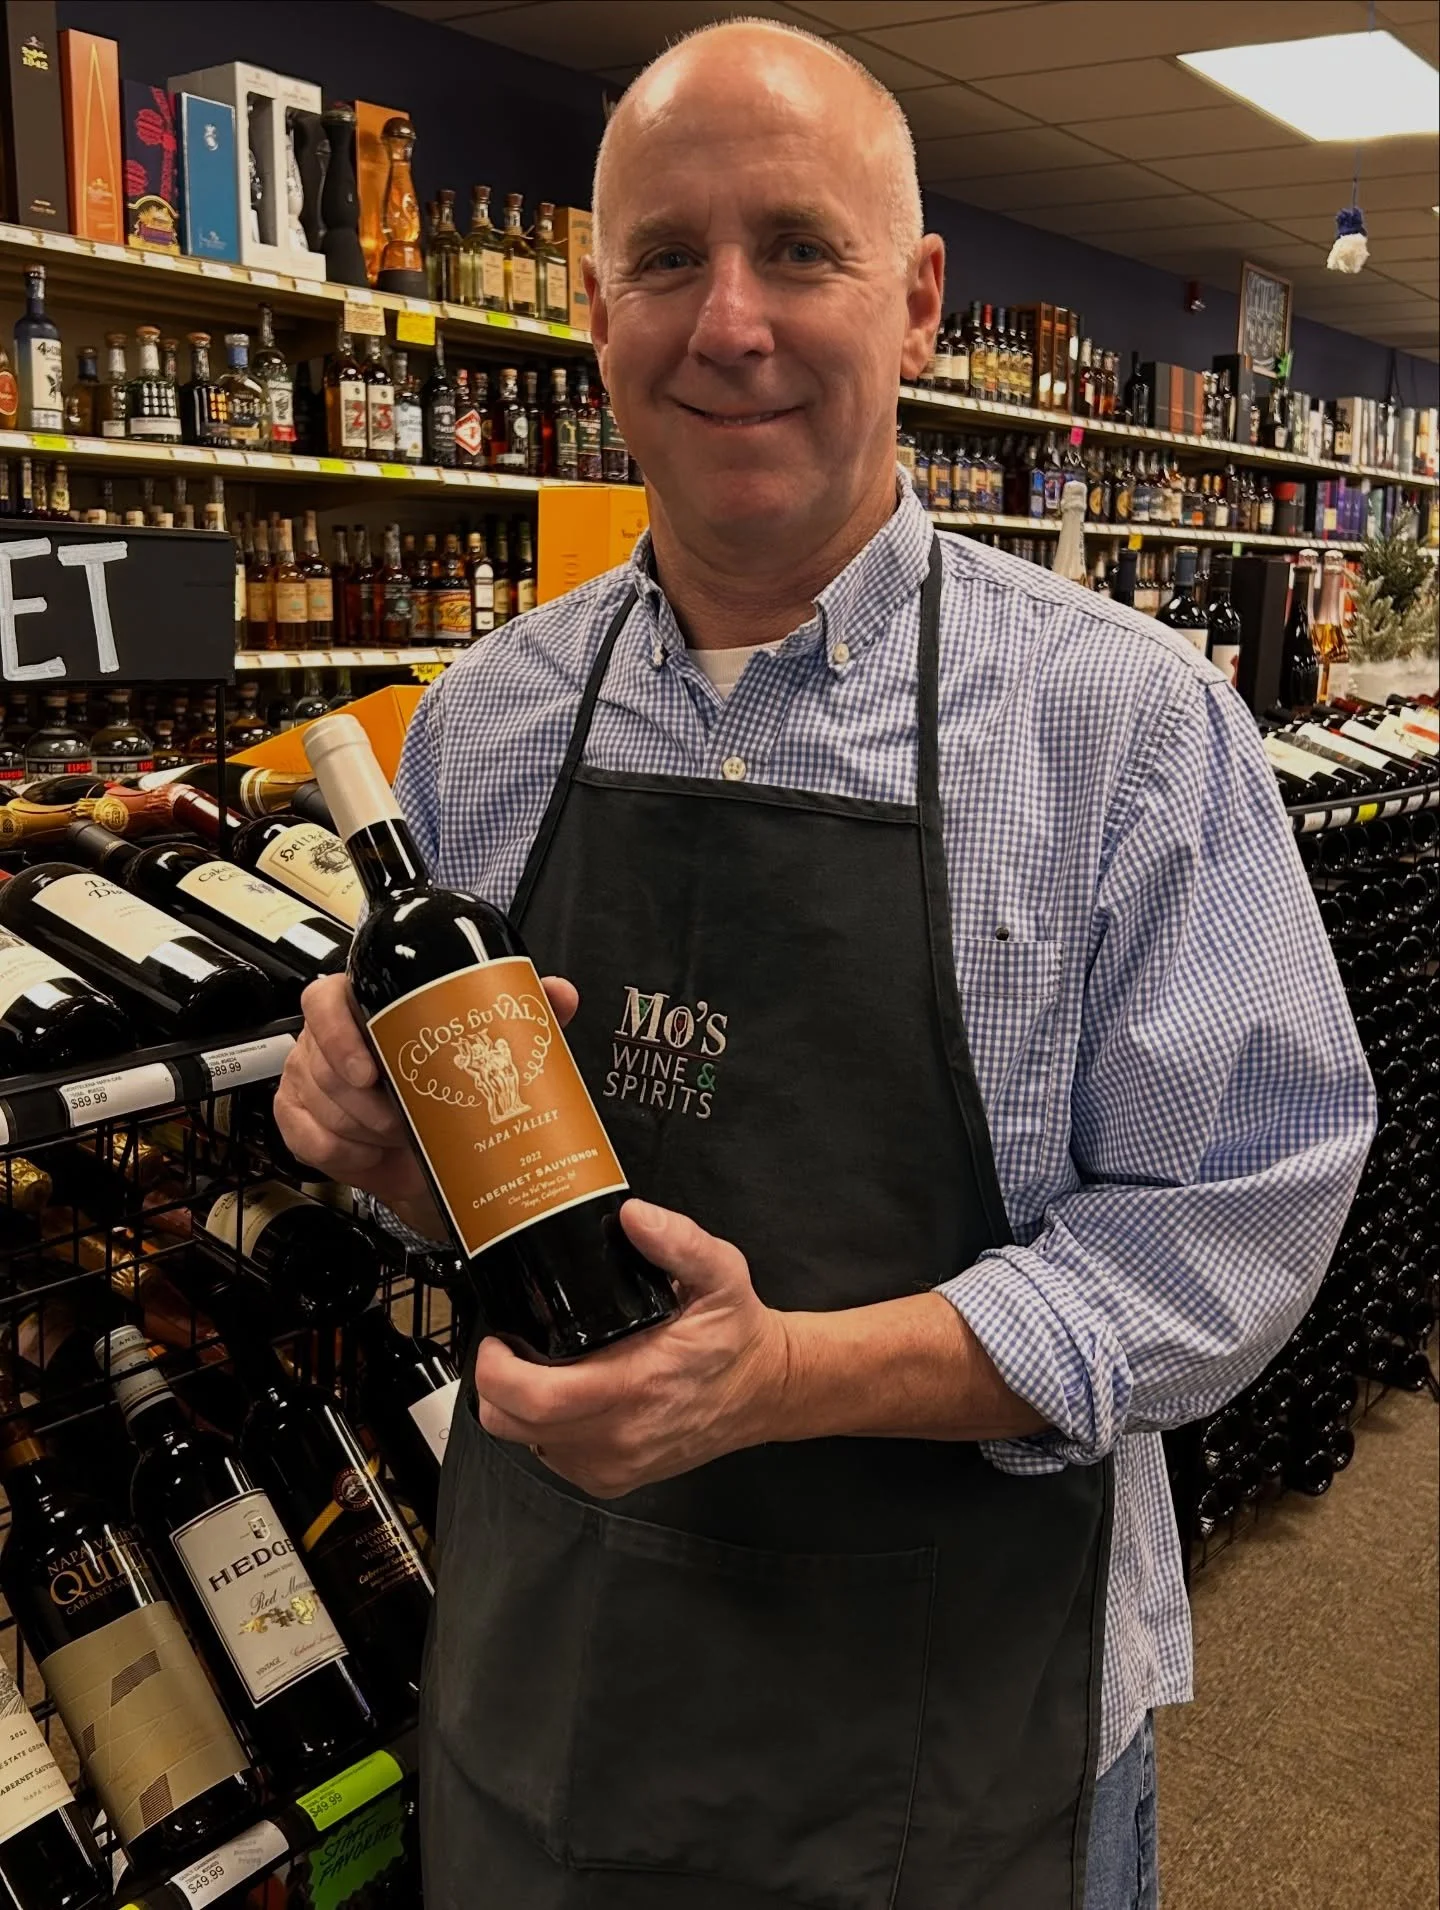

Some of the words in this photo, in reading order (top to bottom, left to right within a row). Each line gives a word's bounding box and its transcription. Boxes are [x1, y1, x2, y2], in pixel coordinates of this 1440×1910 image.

[493, 994, 537, 1021] VAL
[612, 1042, 688, 1083] WINE
[697, 1062, 715, 1092] &
[70, 1092, 108, 1110] $89.99
[603, 1071, 713, 1120] SPIRITS
[474, 1130, 511, 1153] NAPA
[513, 1108, 560, 1136] VALLEY
[519, 1151, 542, 1167] 2022
[472, 1173, 531, 1209] CABERNET
[536, 1148, 599, 1178] SAUVIGNON
[47, 1545, 89, 1577] NAPA
[66, 1585, 113, 1616] CABERNET
[251, 1589, 277, 1616] Red
[255, 1656, 282, 1676] VINTAGE
[309, 1792, 343, 1818] $49.99
[187, 1865, 225, 1895] $49.99
